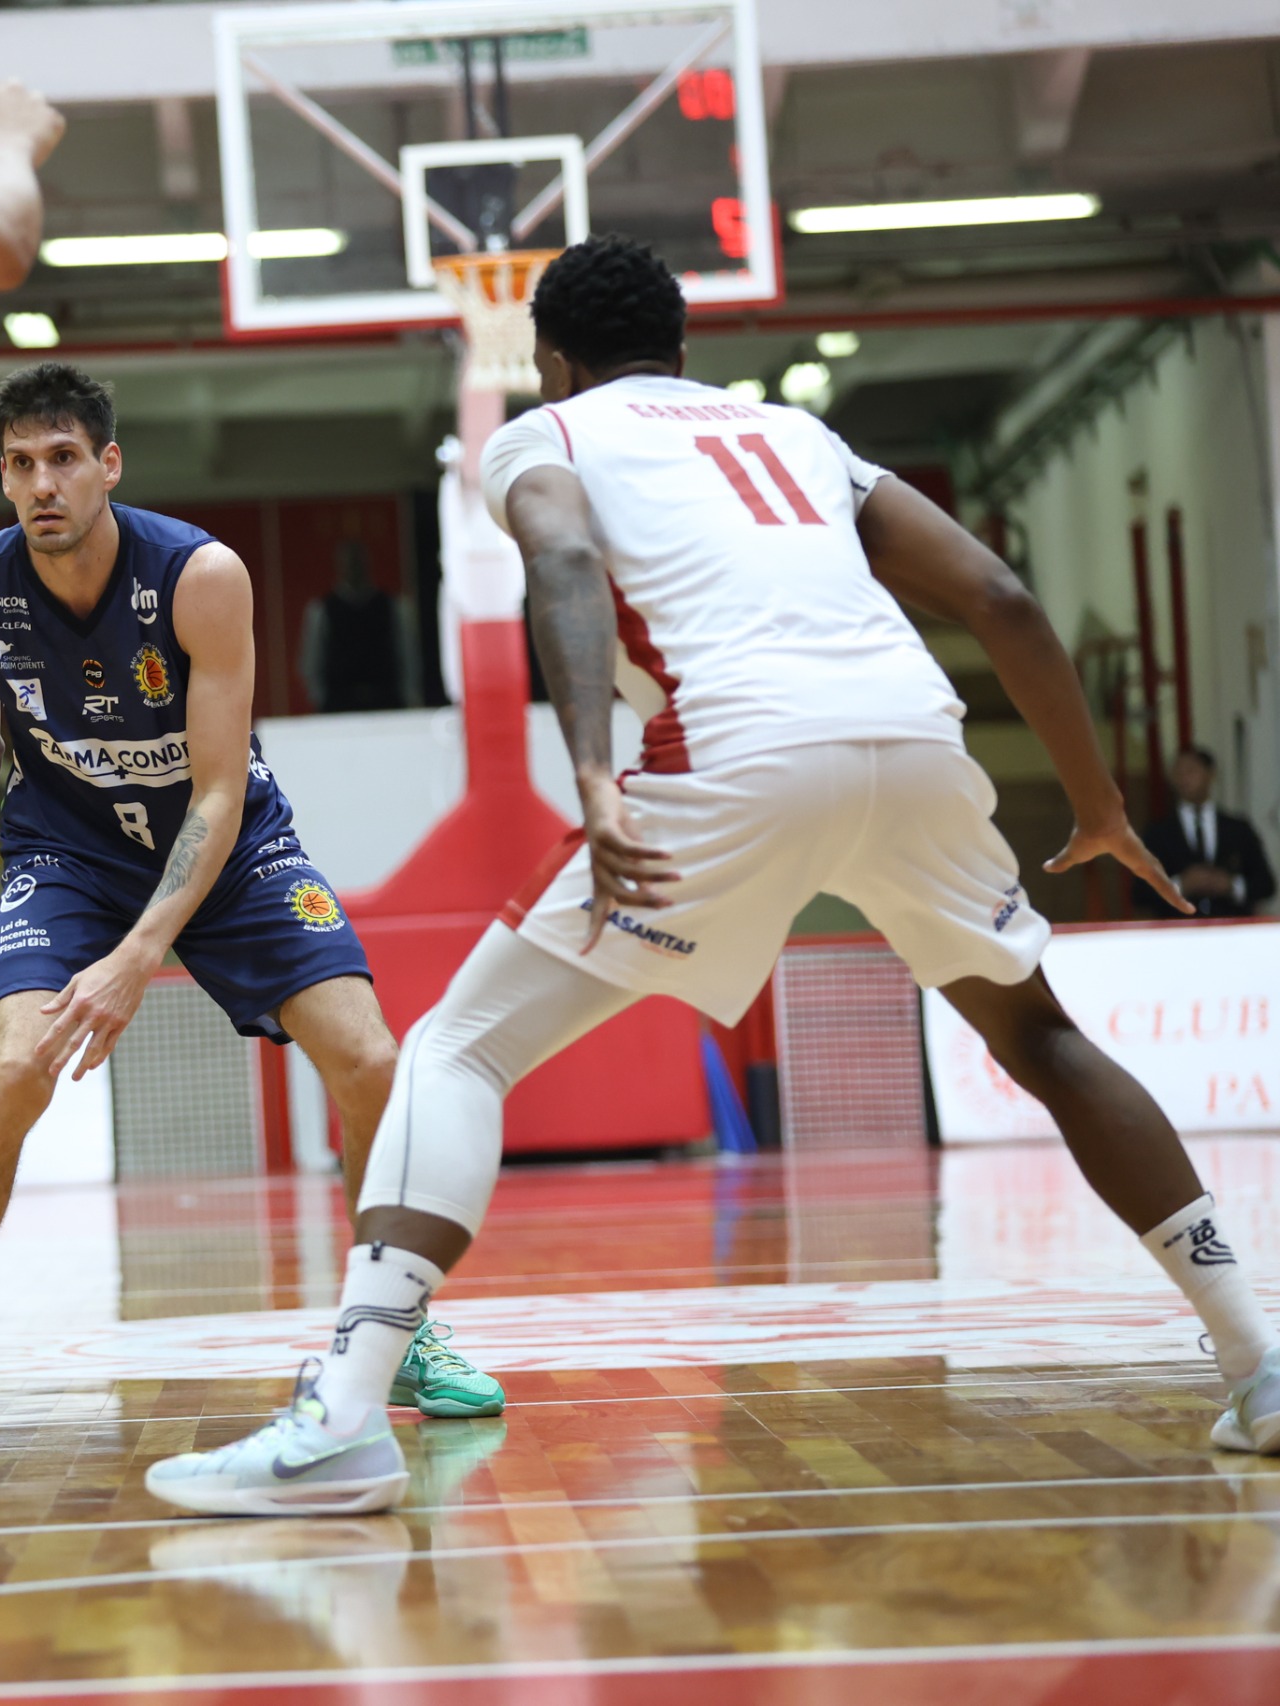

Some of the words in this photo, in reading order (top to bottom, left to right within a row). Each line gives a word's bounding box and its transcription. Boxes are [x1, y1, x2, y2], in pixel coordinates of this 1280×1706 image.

[693, 432, 829, 526] 11
[82, 695, 119, 715] RT
[90, 713, 125, 723] SPORTS
[113, 802, 155, 850] 8
[0, 920, 14, 934] Lei
[14, 918, 29, 928] de
[0, 927, 47, 944] Incentivo
[0, 939, 26, 954] Fiscal
